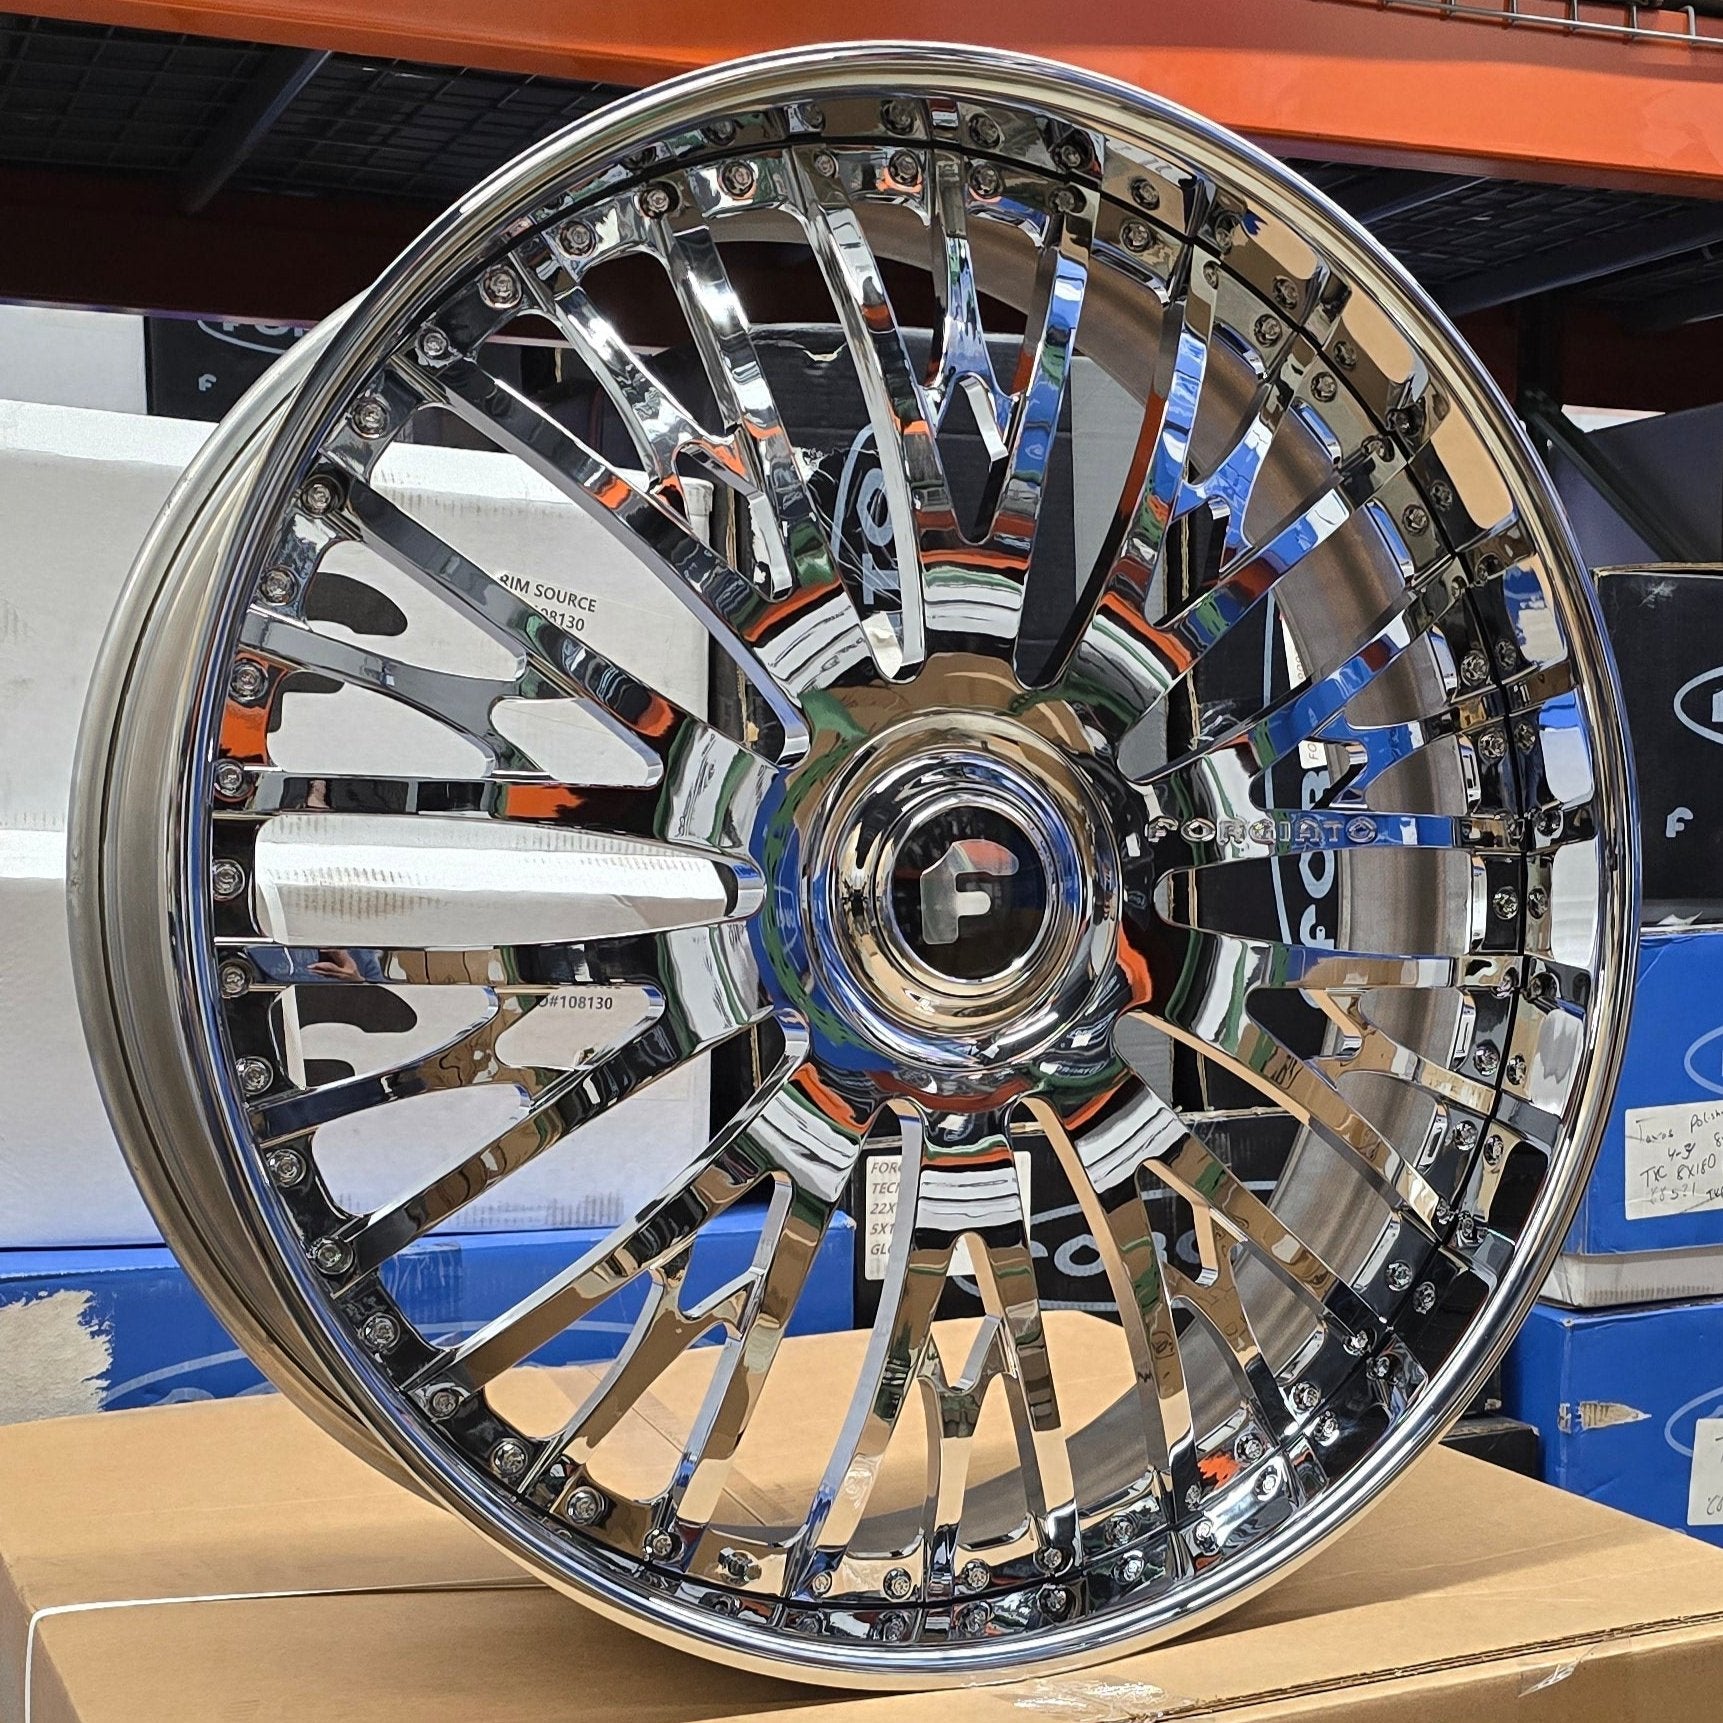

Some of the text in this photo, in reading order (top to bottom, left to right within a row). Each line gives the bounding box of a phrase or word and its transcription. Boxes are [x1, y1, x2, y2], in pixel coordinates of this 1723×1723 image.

[499, 574, 597, 612] RIM SOURCE
[1144, 815, 1378, 846] FORGIATO
[871, 1161, 901, 1175] FOR
[870, 1243, 891, 1256] GL
